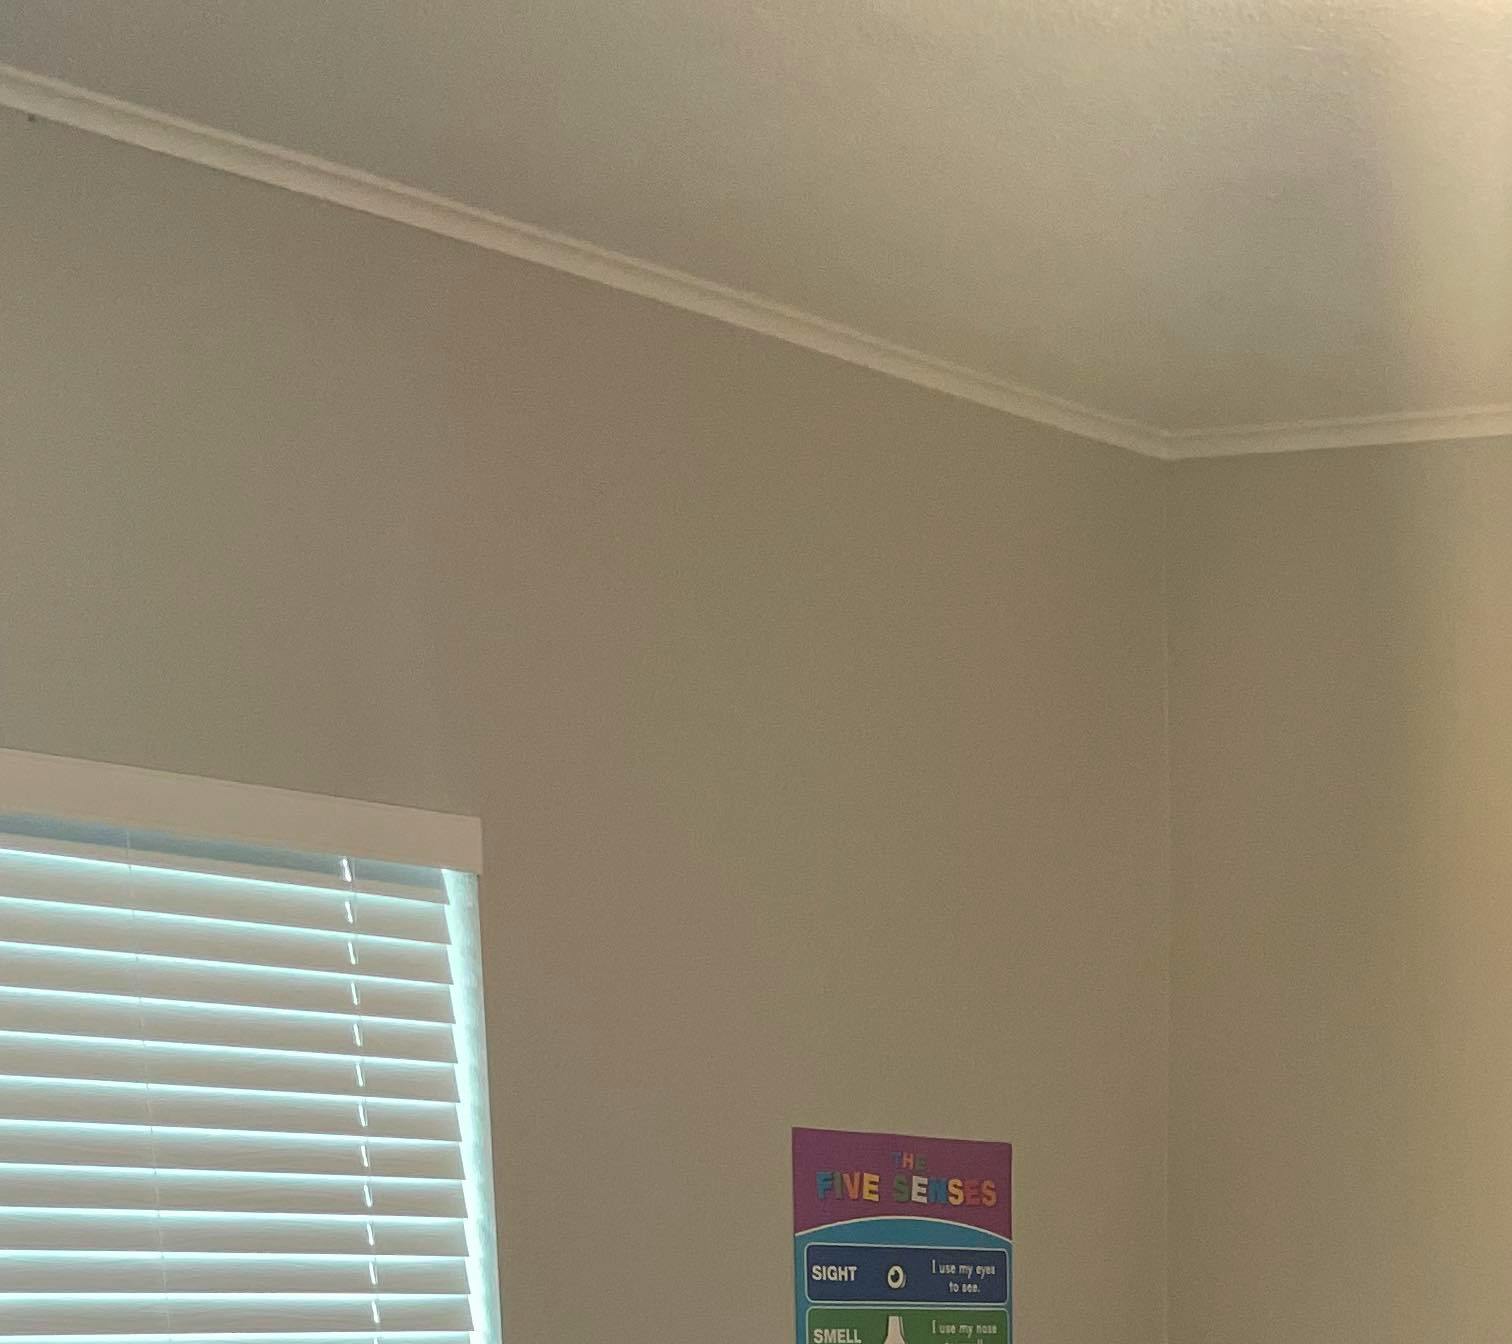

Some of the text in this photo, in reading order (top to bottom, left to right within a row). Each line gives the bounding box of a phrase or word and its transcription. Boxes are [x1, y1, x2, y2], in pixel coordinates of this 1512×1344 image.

[892, 1152, 926, 1170] THE
[816, 1172, 997, 1207] FIVE SENSES
[811, 1265, 857, 1281] SIGHT
[939, 1263, 955, 1275] use
[959, 1263, 973, 1278] my
[949, 1282, 959, 1293] to
[813, 1328, 861, 1344] SMELL
[939, 1323, 955, 1334] use
[959, 1324, 973, 1337] my
[976, 1324, 997, 1334] nose
